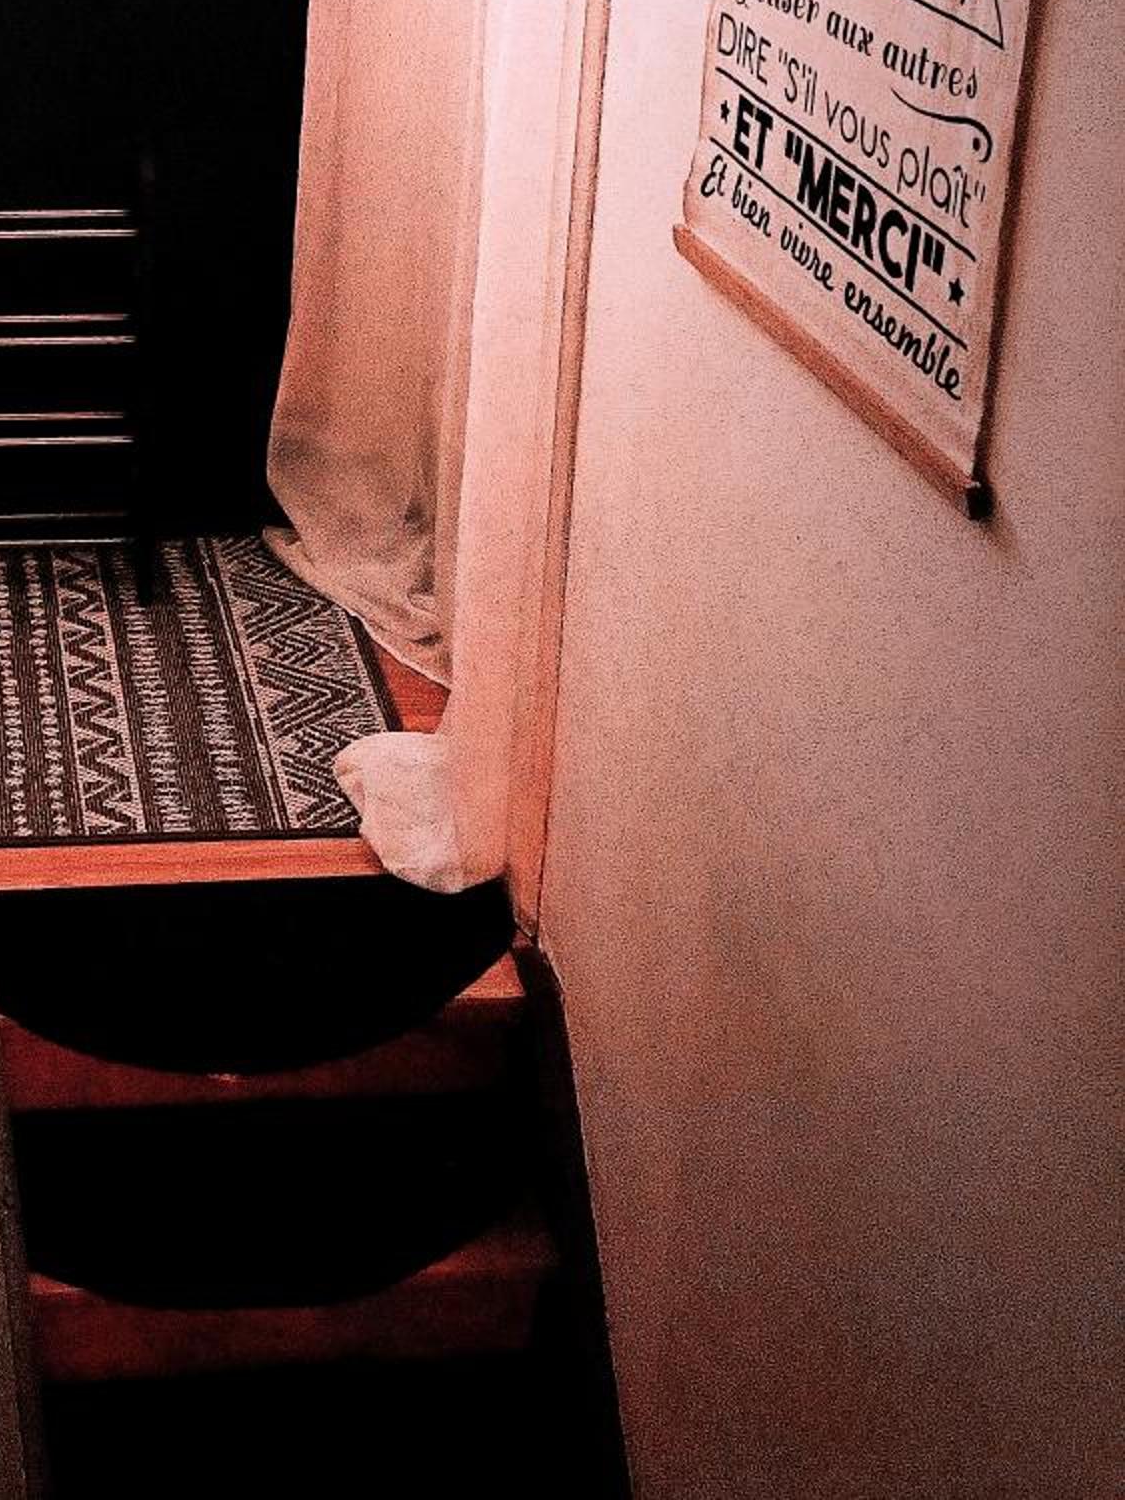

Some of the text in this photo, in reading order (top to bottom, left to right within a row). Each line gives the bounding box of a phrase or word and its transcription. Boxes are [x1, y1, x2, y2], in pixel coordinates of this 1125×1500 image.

[717, 13, 773, 86] DIRE
[827, 10, 874, 57] aux
[882, 46, 979, 99] autres
[733, 95, 945, 293] ET "MERCI"
[700, 154, 962, 401] Et bien vivre ensemble
